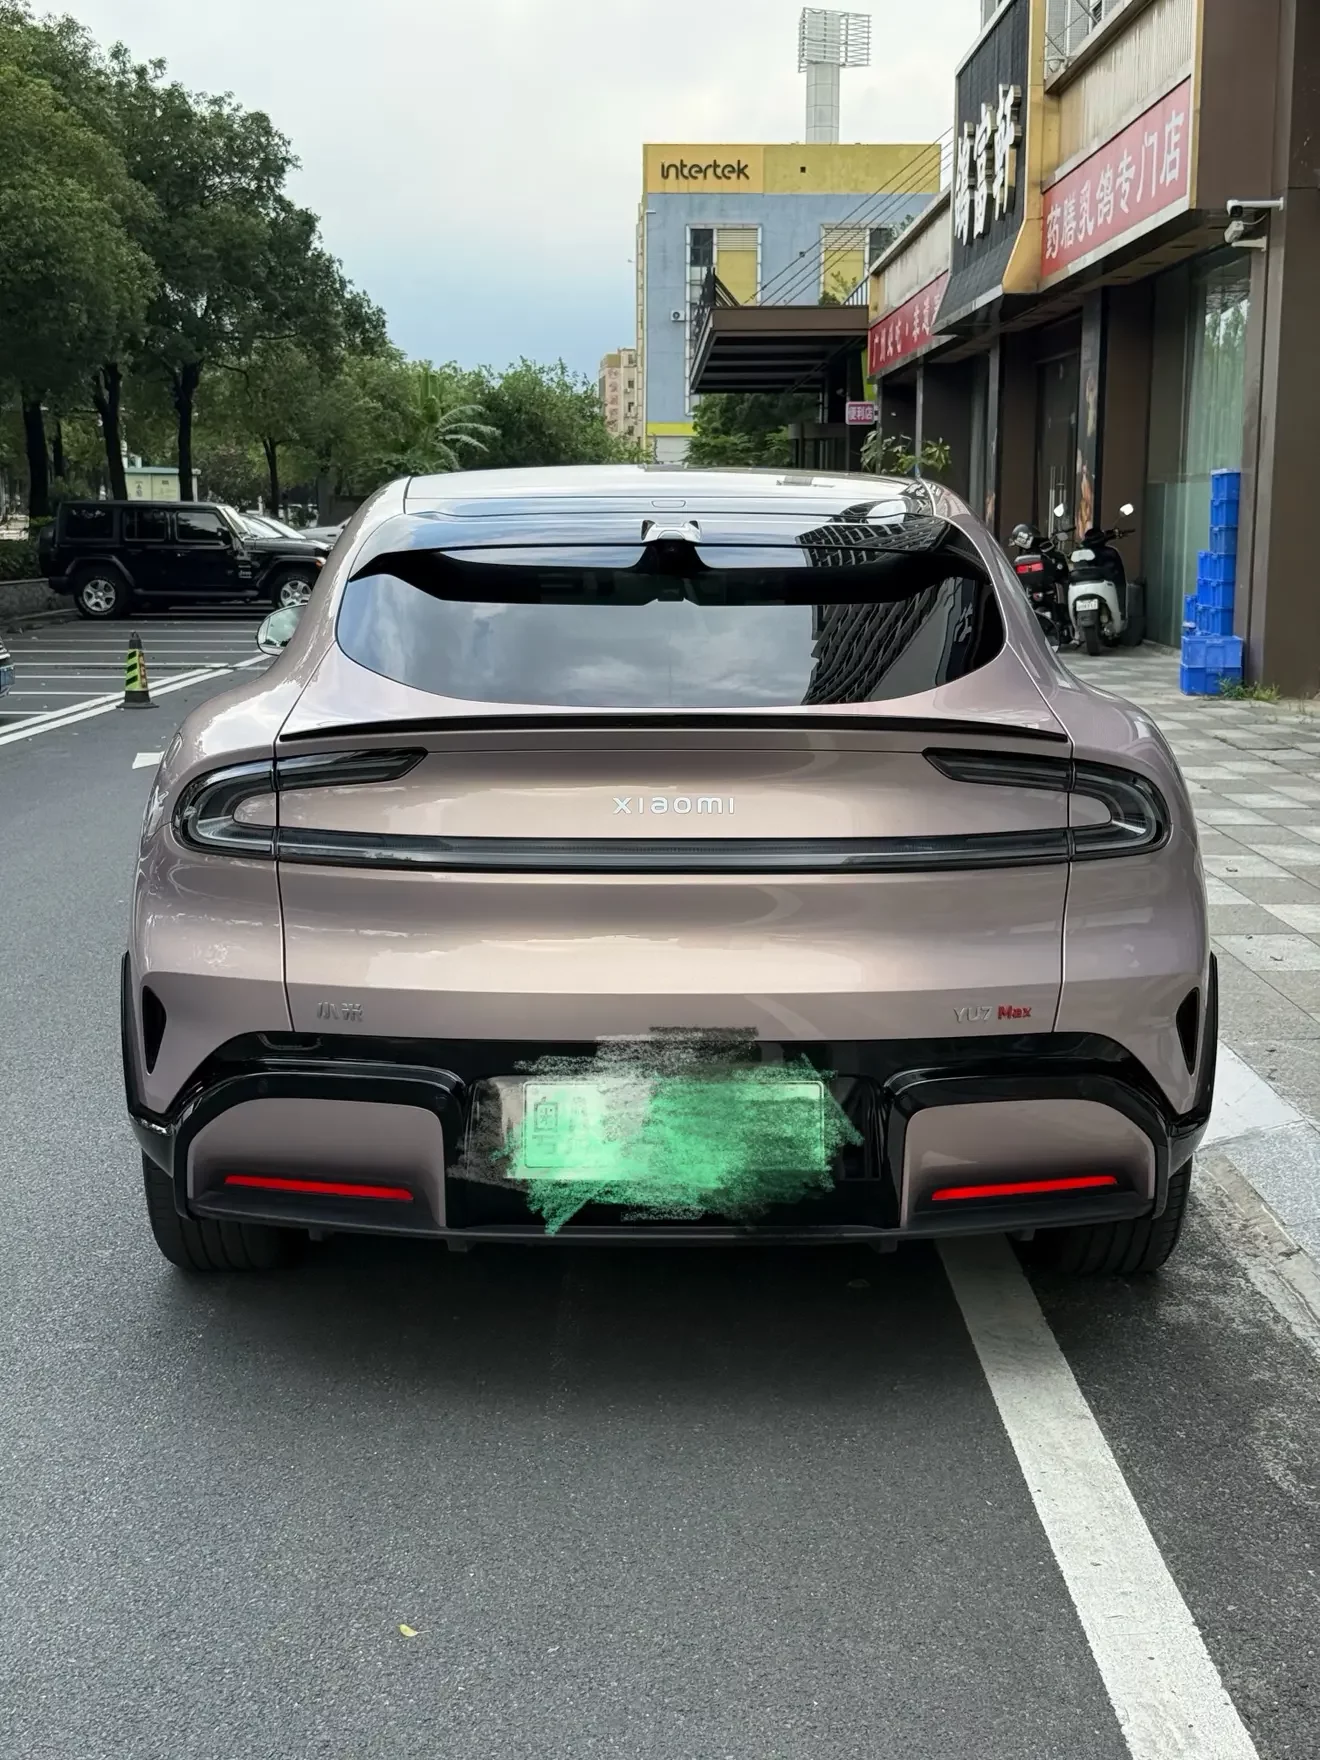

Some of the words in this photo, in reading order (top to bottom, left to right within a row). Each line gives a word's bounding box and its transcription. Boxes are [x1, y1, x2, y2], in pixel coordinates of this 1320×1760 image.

[660, 158, 750, 180] intertek
[1045, 109, 1185, 259] 药膳乳鸽专门店
[847, 405, 874, 421] 便利店
[316, 1001, 364, 1022] 小米
[953, 1005, 993, 1022] YU7
[997, 1004, 1032, 1020] Max
